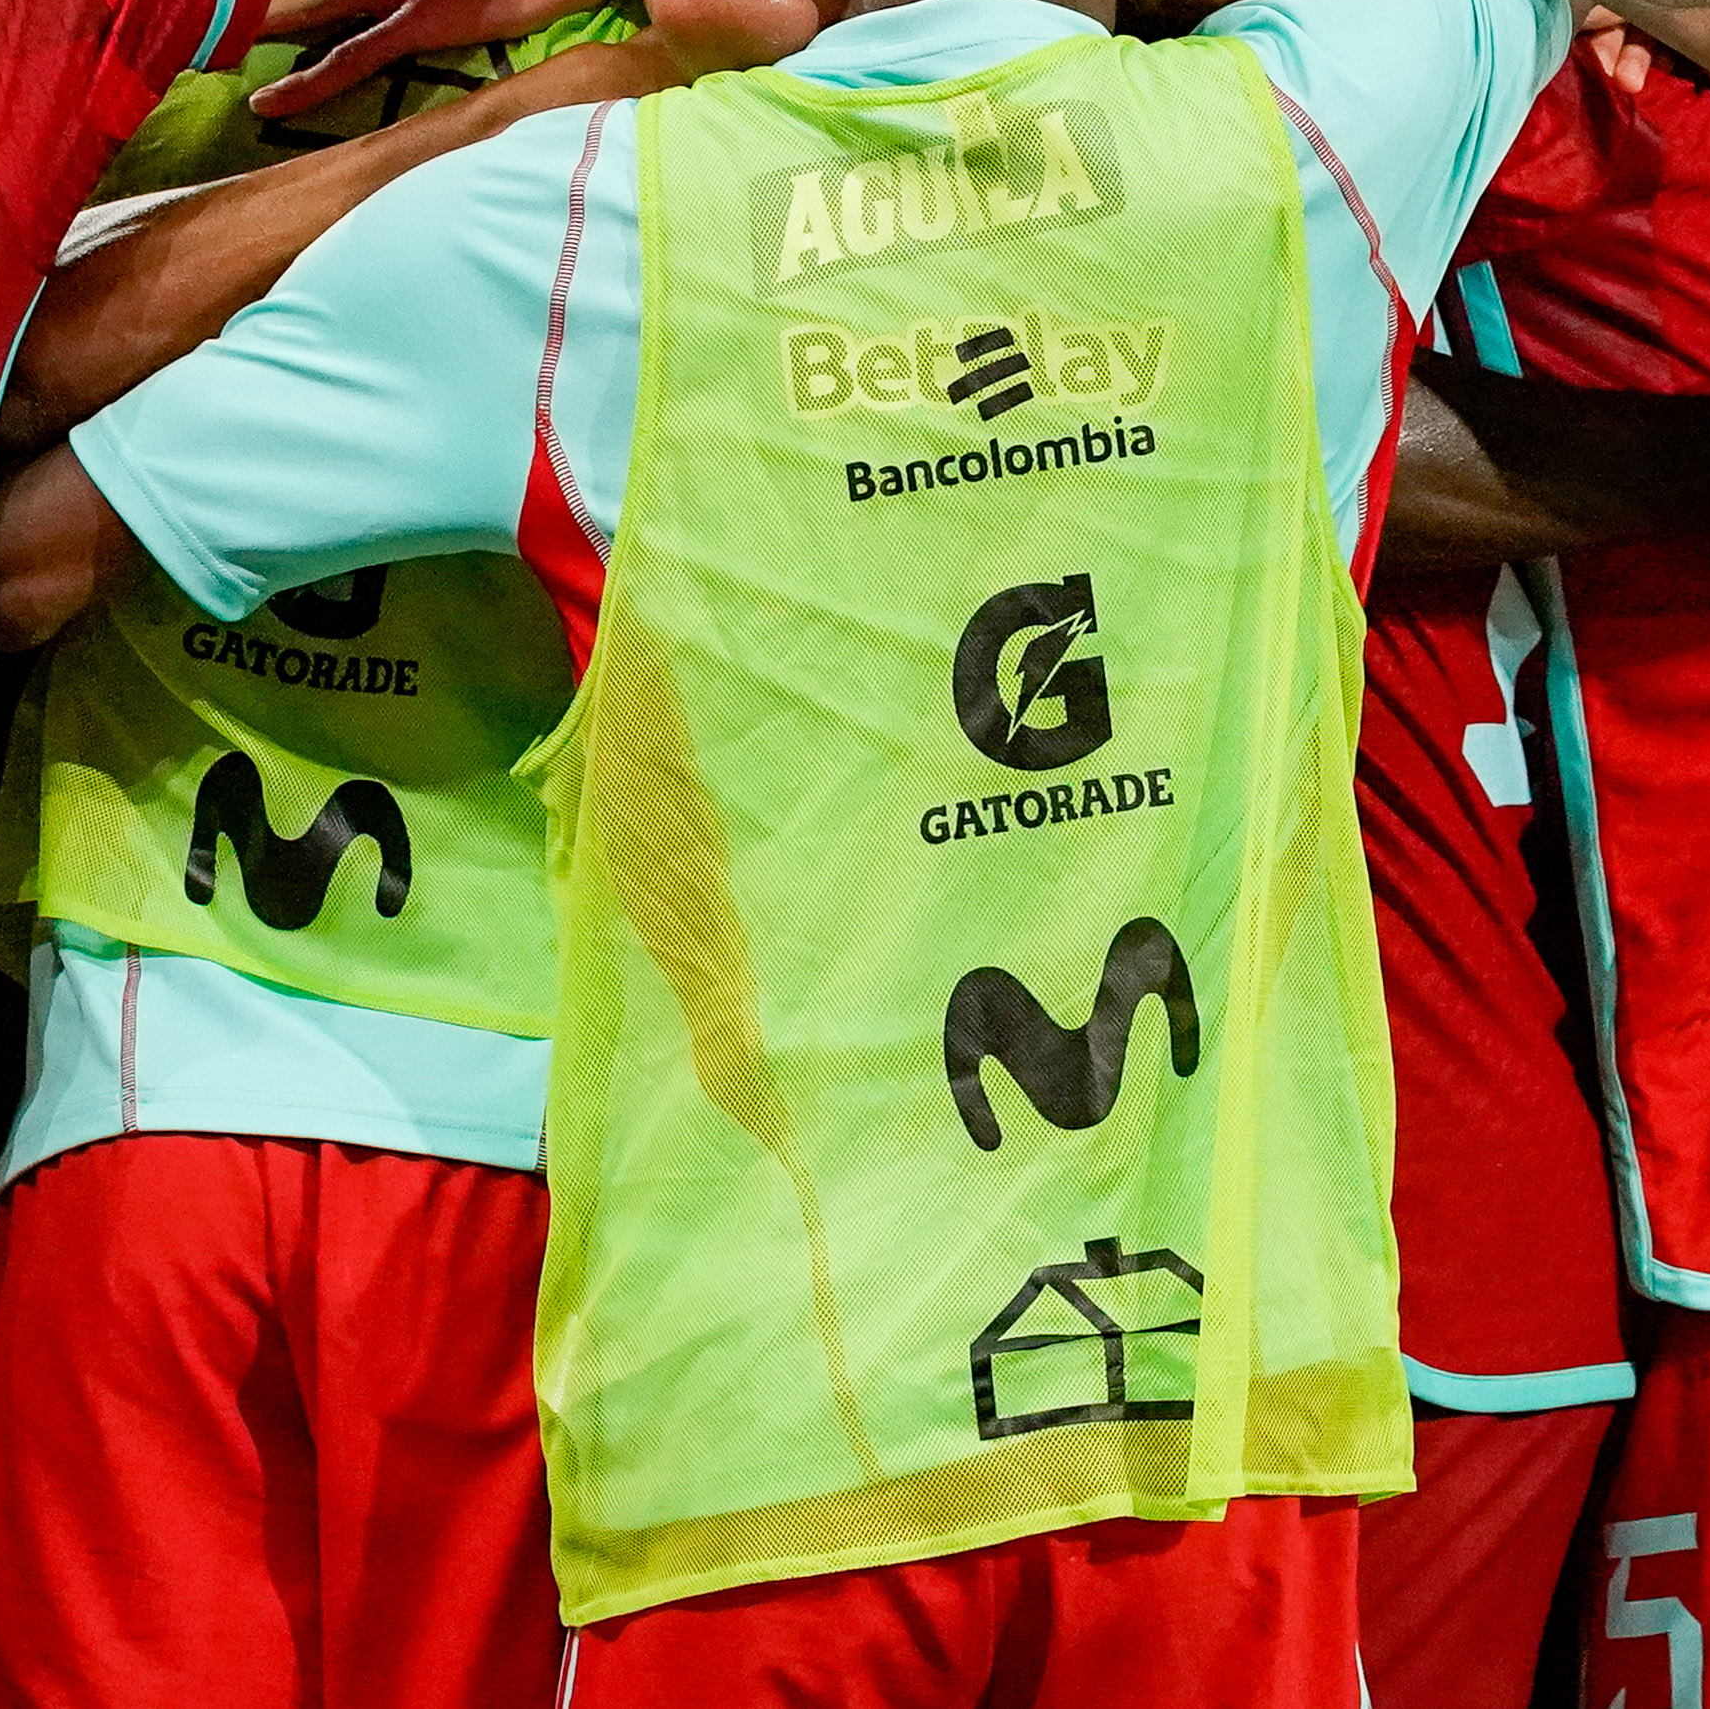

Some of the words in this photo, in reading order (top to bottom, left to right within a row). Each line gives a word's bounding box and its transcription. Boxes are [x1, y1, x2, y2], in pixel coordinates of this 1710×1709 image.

[845, 415, 1158, 503] Bancolombia
[182, 622, 420, 697] GATORADE
[919, 767, 1175, 845] GATORADE
